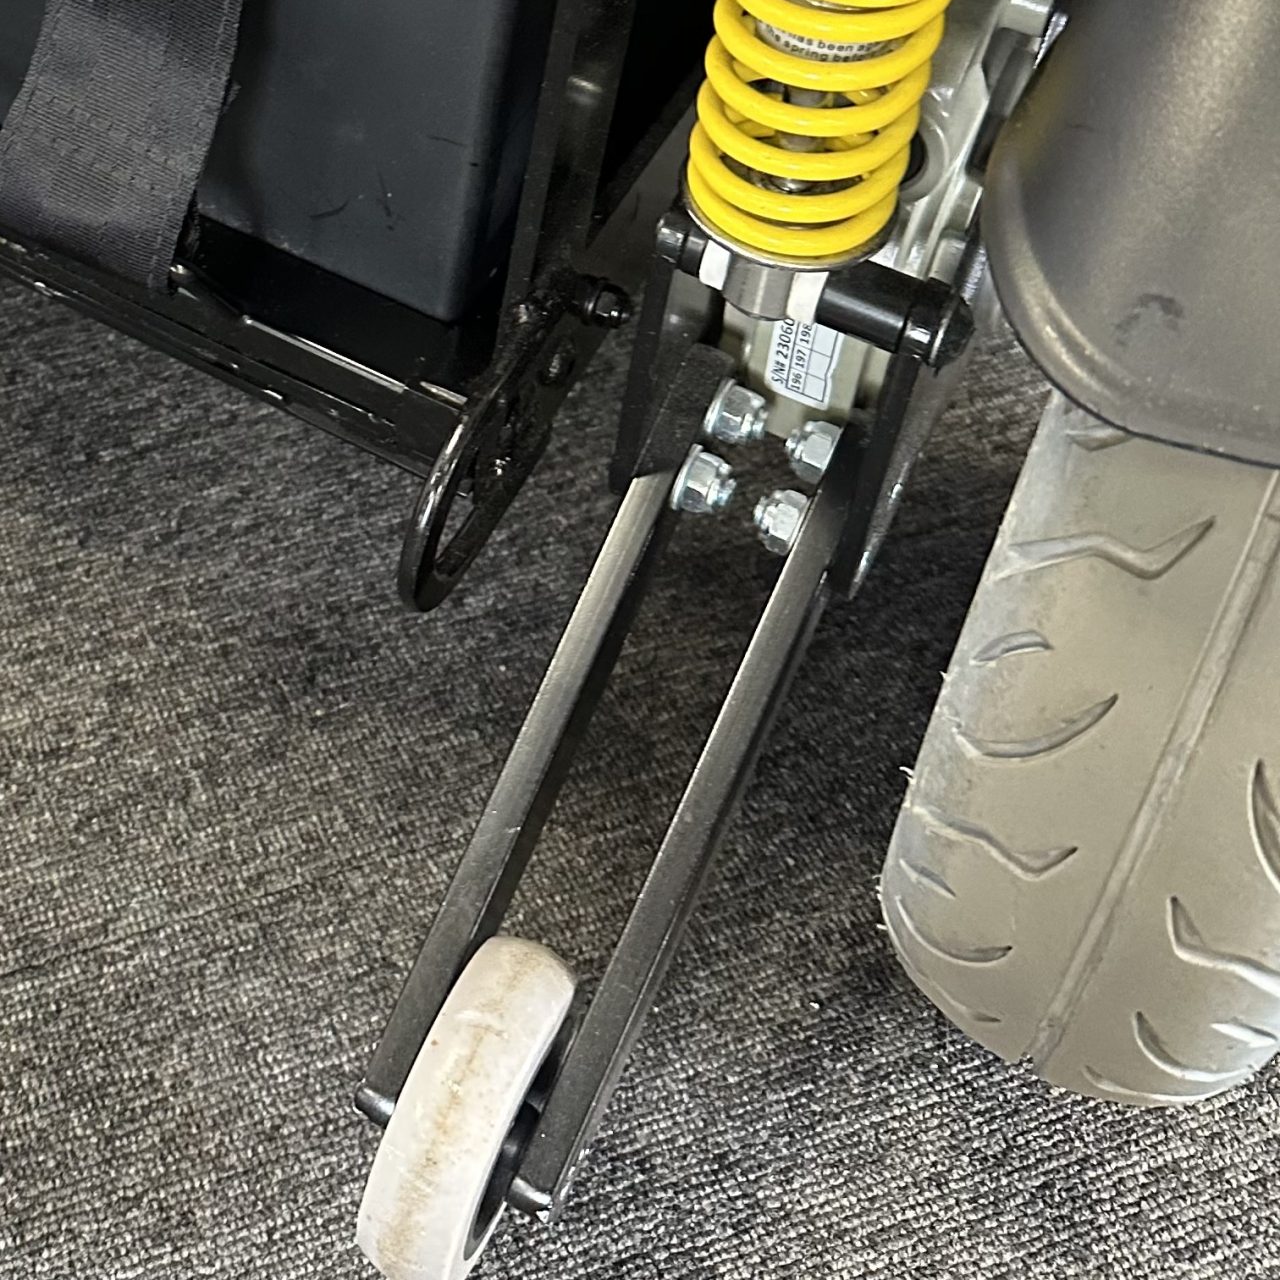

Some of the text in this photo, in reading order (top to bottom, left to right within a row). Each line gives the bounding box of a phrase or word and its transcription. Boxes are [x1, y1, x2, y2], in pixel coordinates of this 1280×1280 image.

[783, 40, 829, 62] spring
[817, 38, 853, 53] been
[791, 323, 813, 390] 196 197 198
